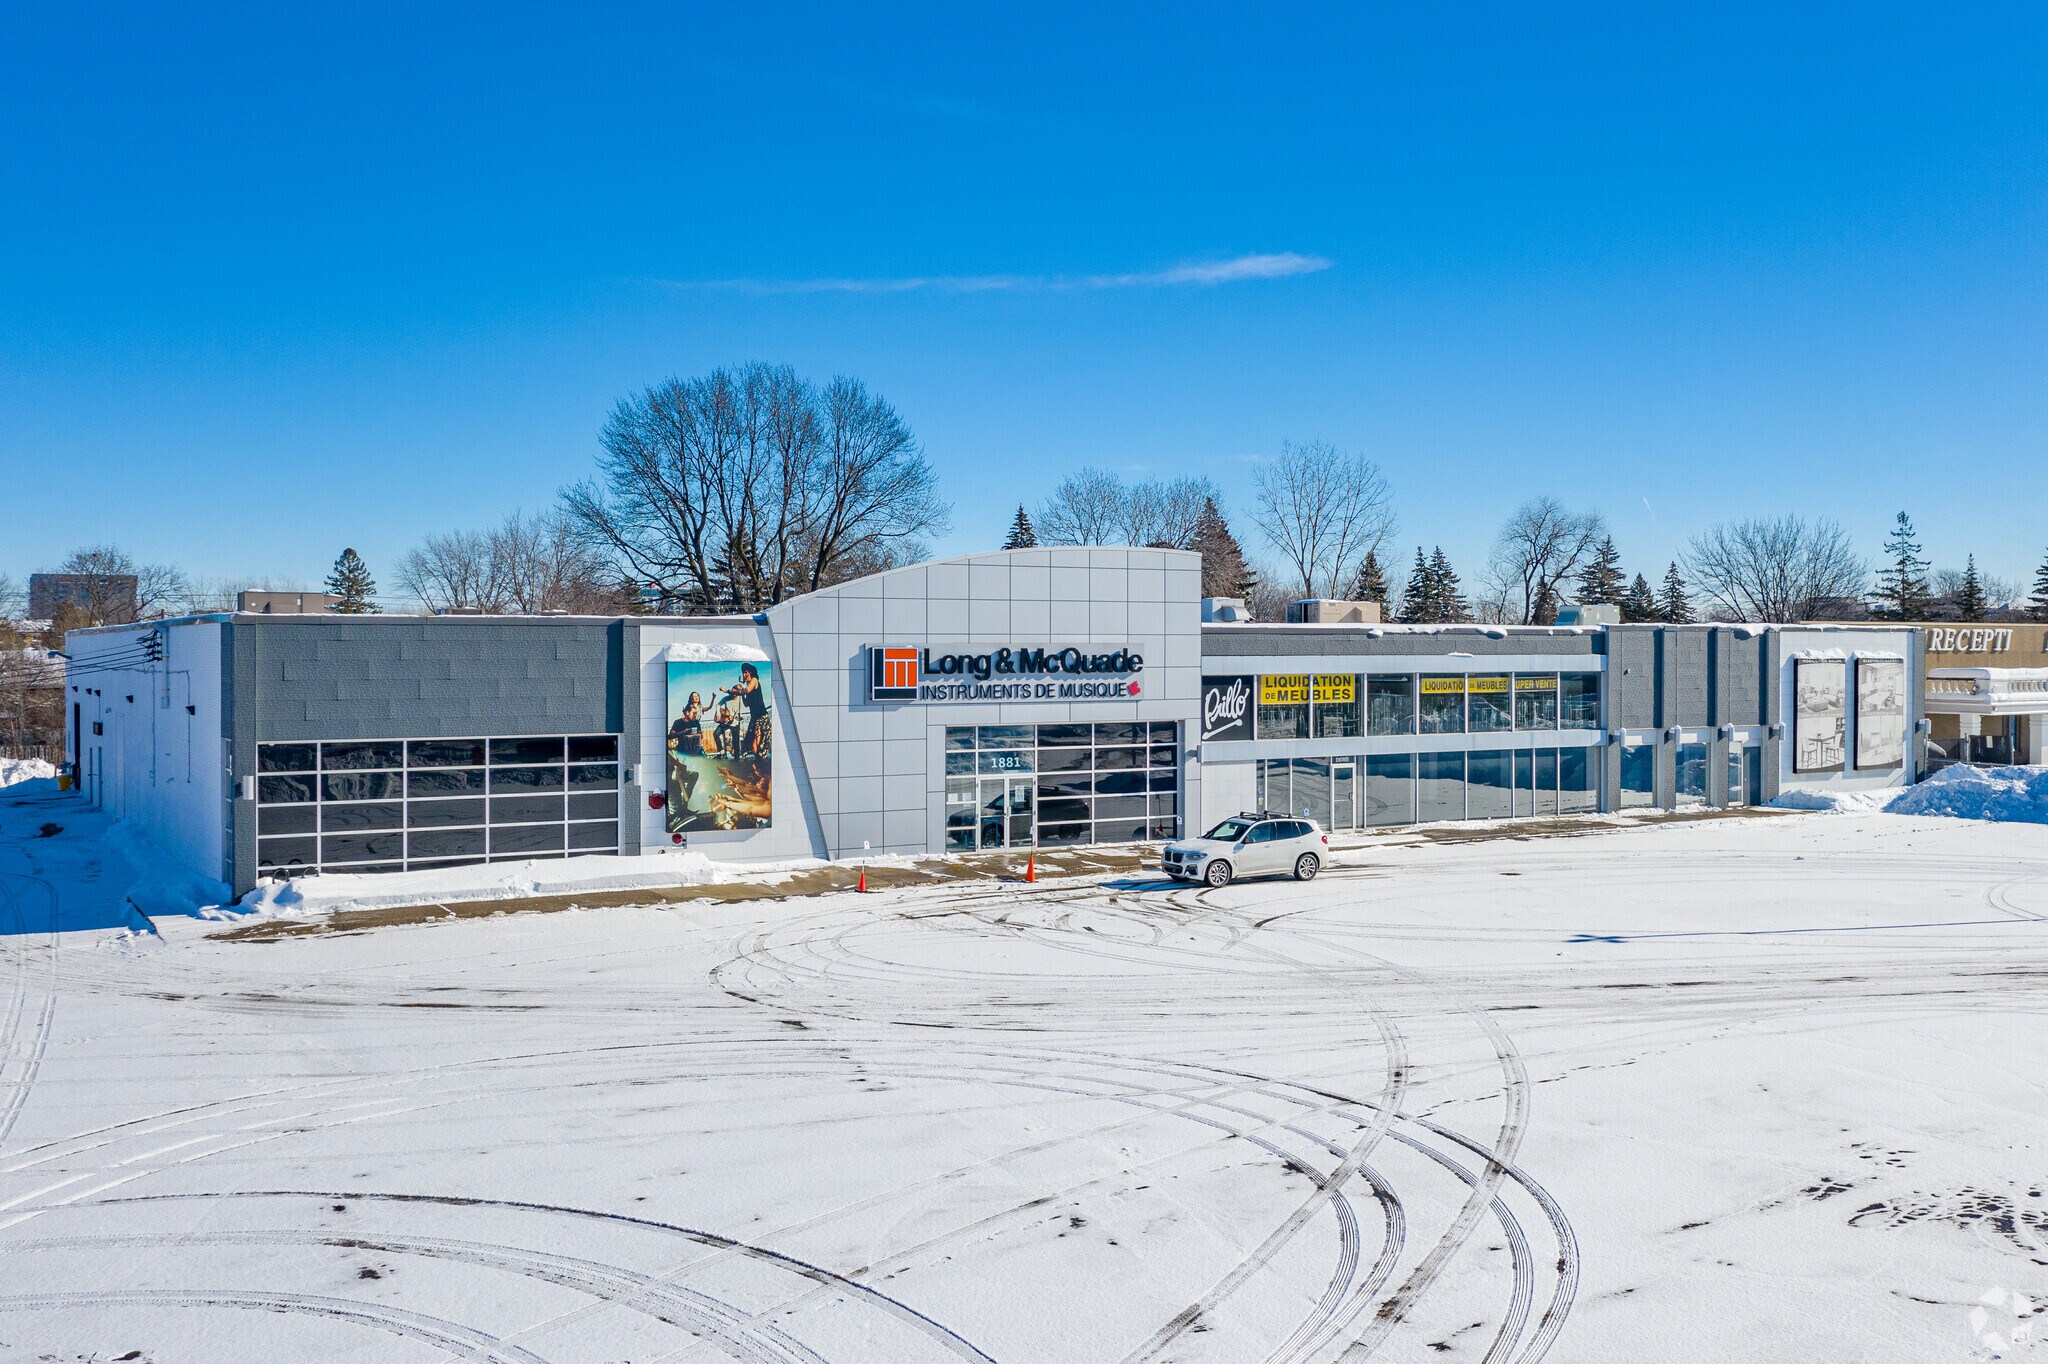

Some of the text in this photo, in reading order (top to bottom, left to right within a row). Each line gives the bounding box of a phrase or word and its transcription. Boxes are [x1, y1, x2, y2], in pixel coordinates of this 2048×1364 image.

[1929, 628, 2013, 651] RECEPTI
[923, 647, 1144, 680] Long & McQuade
[1265, 675, 1351, 688] LIQUIDATION
[1424, 681, 1464, 691] LIQUIDATIO
[1476, 680, 1507, 690] MEUBLES
[1515, 679, 1557, 689] UPER VENTE
[922, 681, 1128, 700] INSTRUMENTS DE MUSIQUE
[1265, 688, 1351, 701] DE MEUBLES
[991, 756, 1021, 768] 1881
